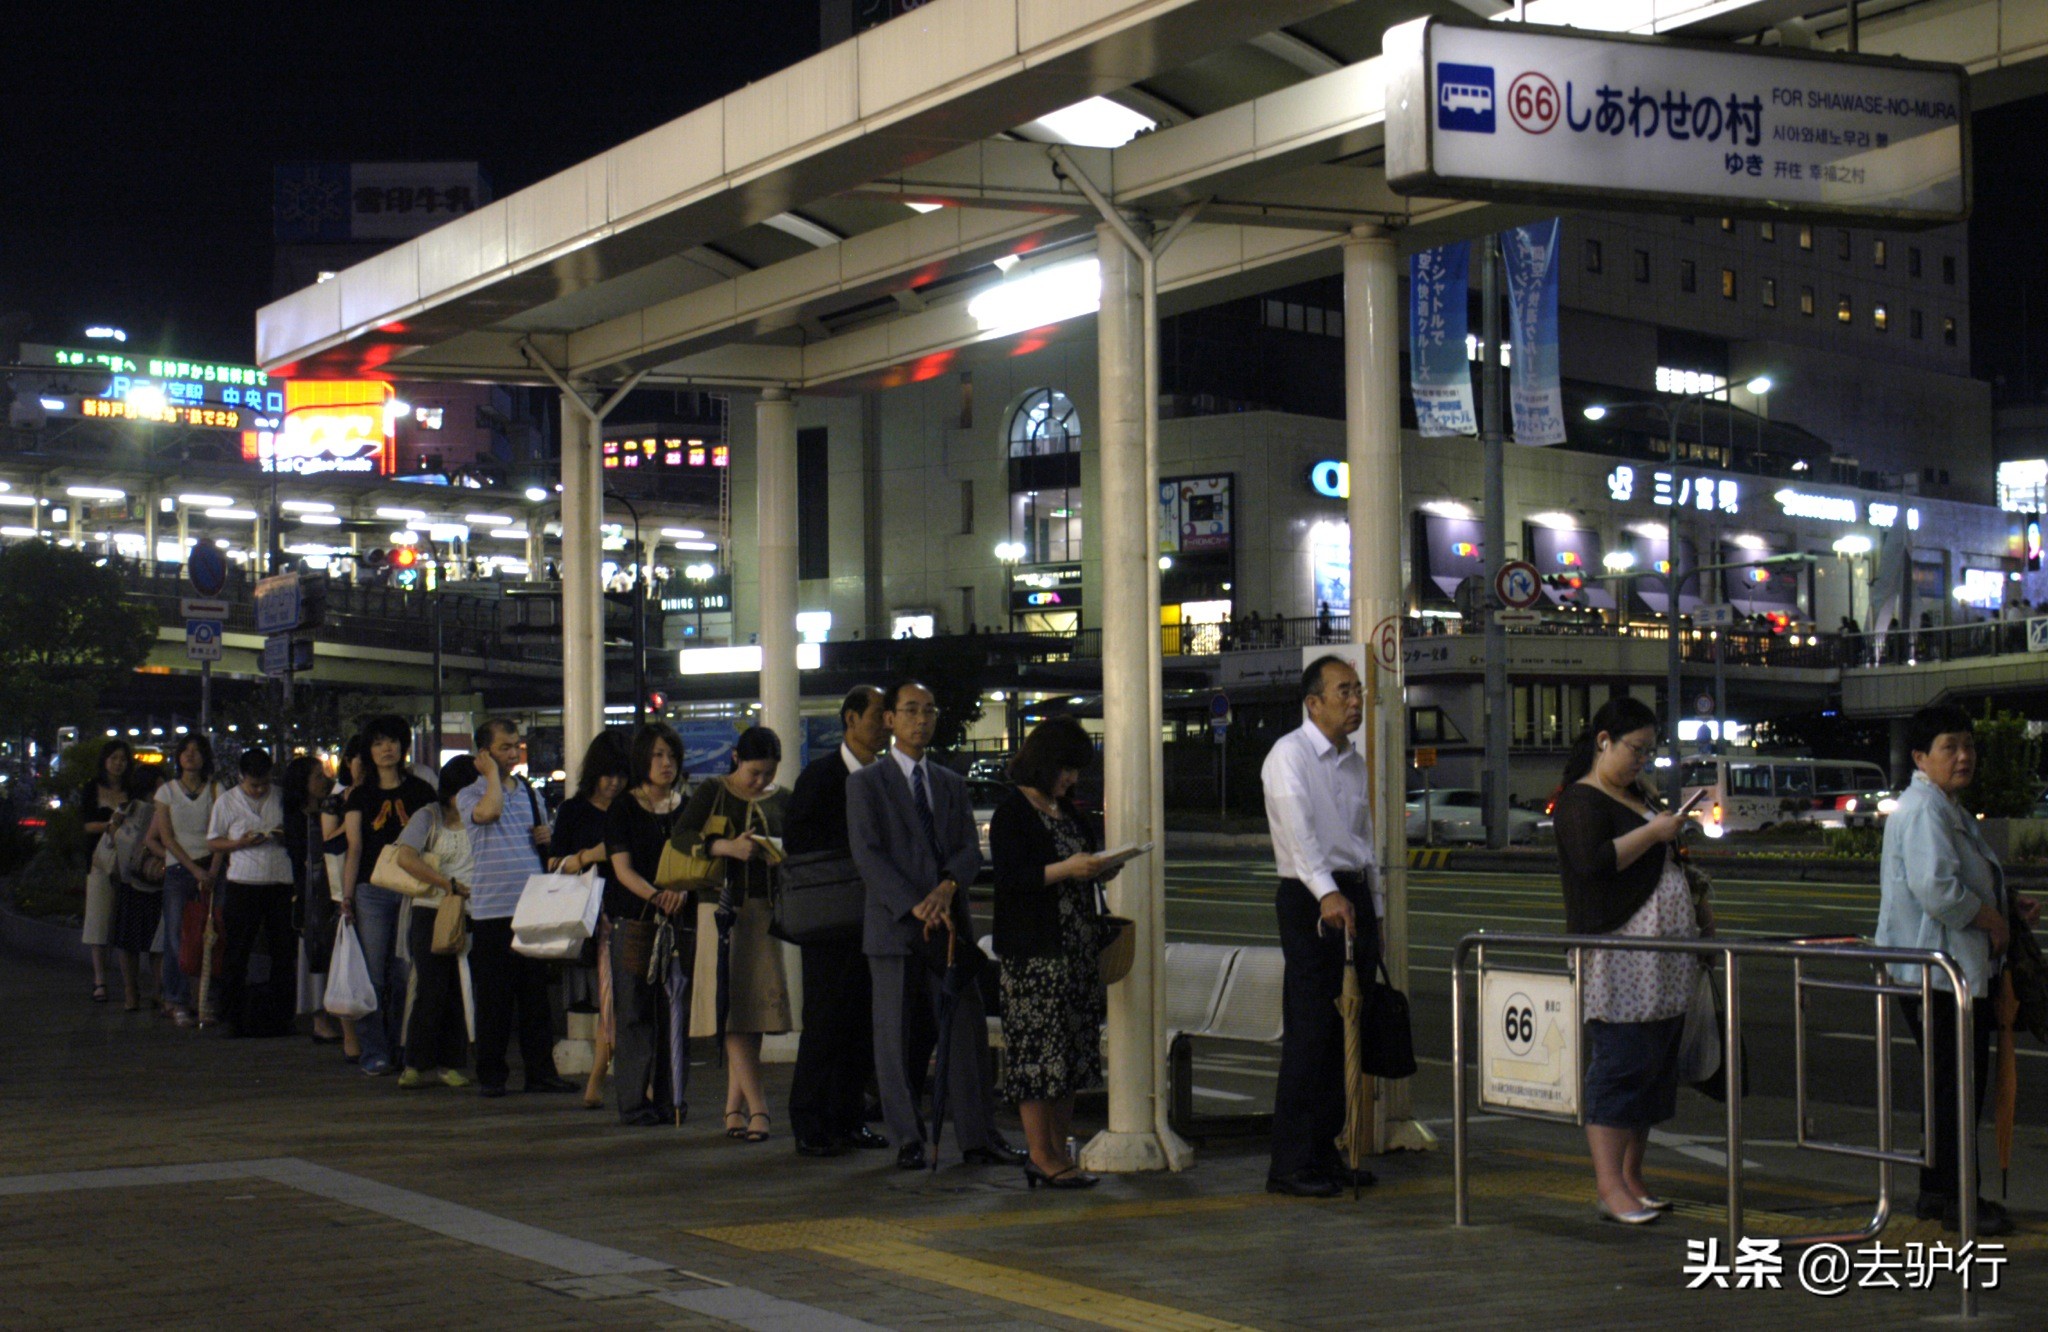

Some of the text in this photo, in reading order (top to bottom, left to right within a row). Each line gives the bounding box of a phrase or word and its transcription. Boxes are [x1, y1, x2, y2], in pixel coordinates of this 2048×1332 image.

[1515, 84, 1553, 121] 66
[1566, 81, 1763, 147] しあわせの村
[1772, 88, 1957, 120] FOR SHIAWASE-NO-MURA
[1724, 152, 1763, 176] ゆき
[1810, 164, 1865, 184] 幸福之村
[222, 388, 283, 413] 中央口
[1505, 1006, 1533, 1043] 66
